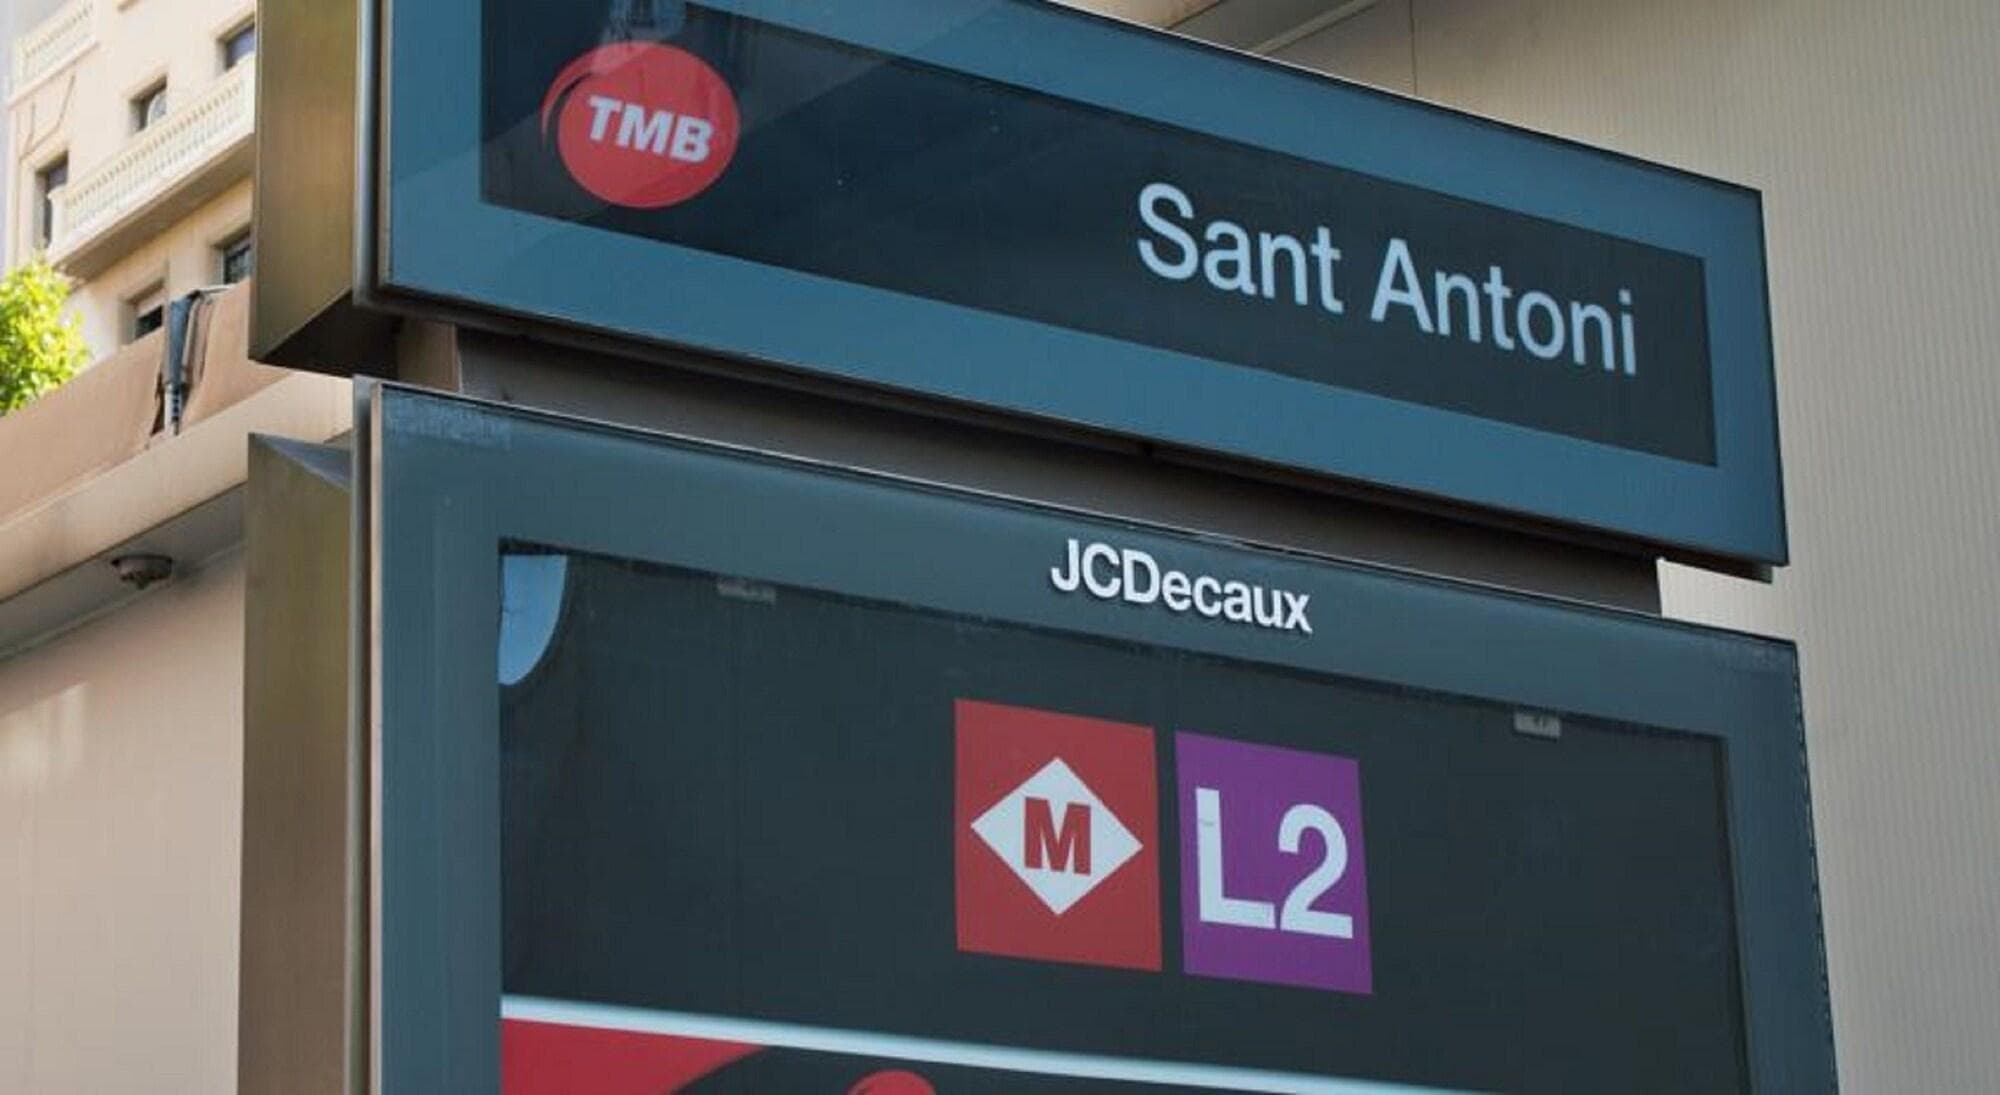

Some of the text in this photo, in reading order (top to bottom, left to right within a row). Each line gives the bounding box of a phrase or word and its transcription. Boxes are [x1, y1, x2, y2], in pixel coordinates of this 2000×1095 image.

[587, 95, 714, 164] TMB
[1137, 183, 1637, 375] Sant Antoni
[1050, 538, 1313, 634] JCDecaux
[1024, 796, 1092, 876] M
[1196, 787, 1354, 939] L2
